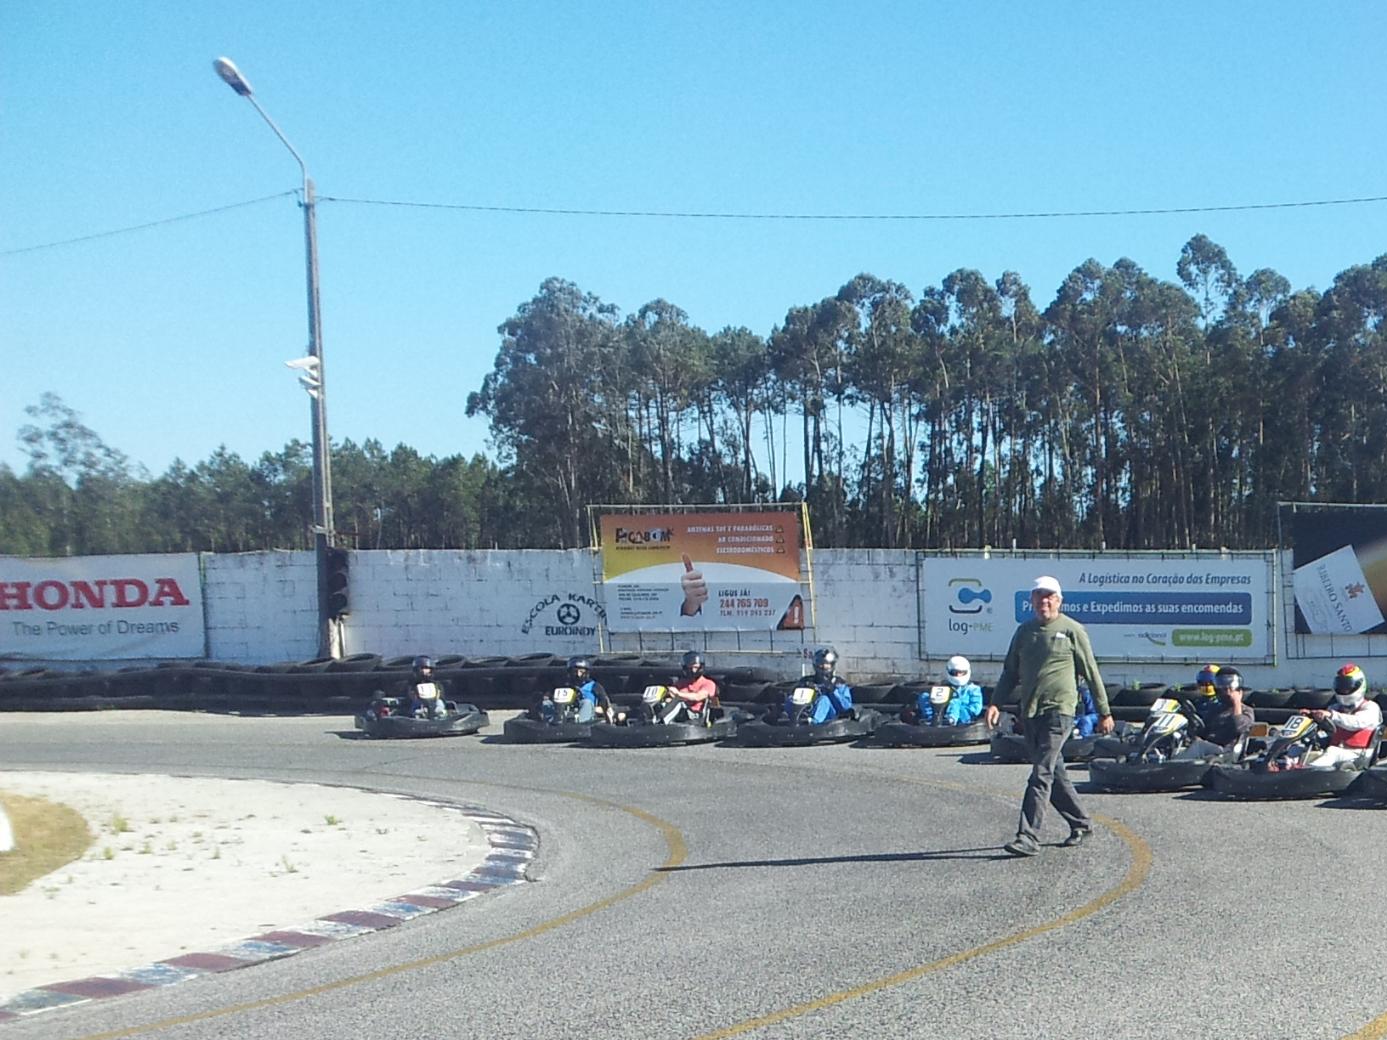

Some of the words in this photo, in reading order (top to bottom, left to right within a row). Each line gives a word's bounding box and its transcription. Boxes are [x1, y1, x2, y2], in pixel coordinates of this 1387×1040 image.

[1079, 572, 1086, 583] A
[1088, 573, 1130, 586] Logística
[1132, 575, 1144, 584] no
[1146, 573, 1184, 586] Coração
[1186, 574, 1203, 584] das
[1205, 574, 1251, 586] Empresas
[0, 578, 190, 610] HONDA
[521, 594, 560, 634] ESCOLA
[1083, 604, 1088, 612] e
[1090, 601, 1143, 614] Expedimos
[1145, 605, 1156, 613] as
[1158, 605, 1179, 613] suas
[1181, 602, 1243, 613] encomendas
[13, 621, 41, 636] The
[46, 621, 92, 636] Power
[98, 620, 113, 635] of
[117, 620, 180, 635] Dreams
[545, 626, 596, 636] EUROINDY
[936, 687, 944, 697] 2
[1158, 715, 1175, 727] 11
[1286, 716, 1304, 730] 18
